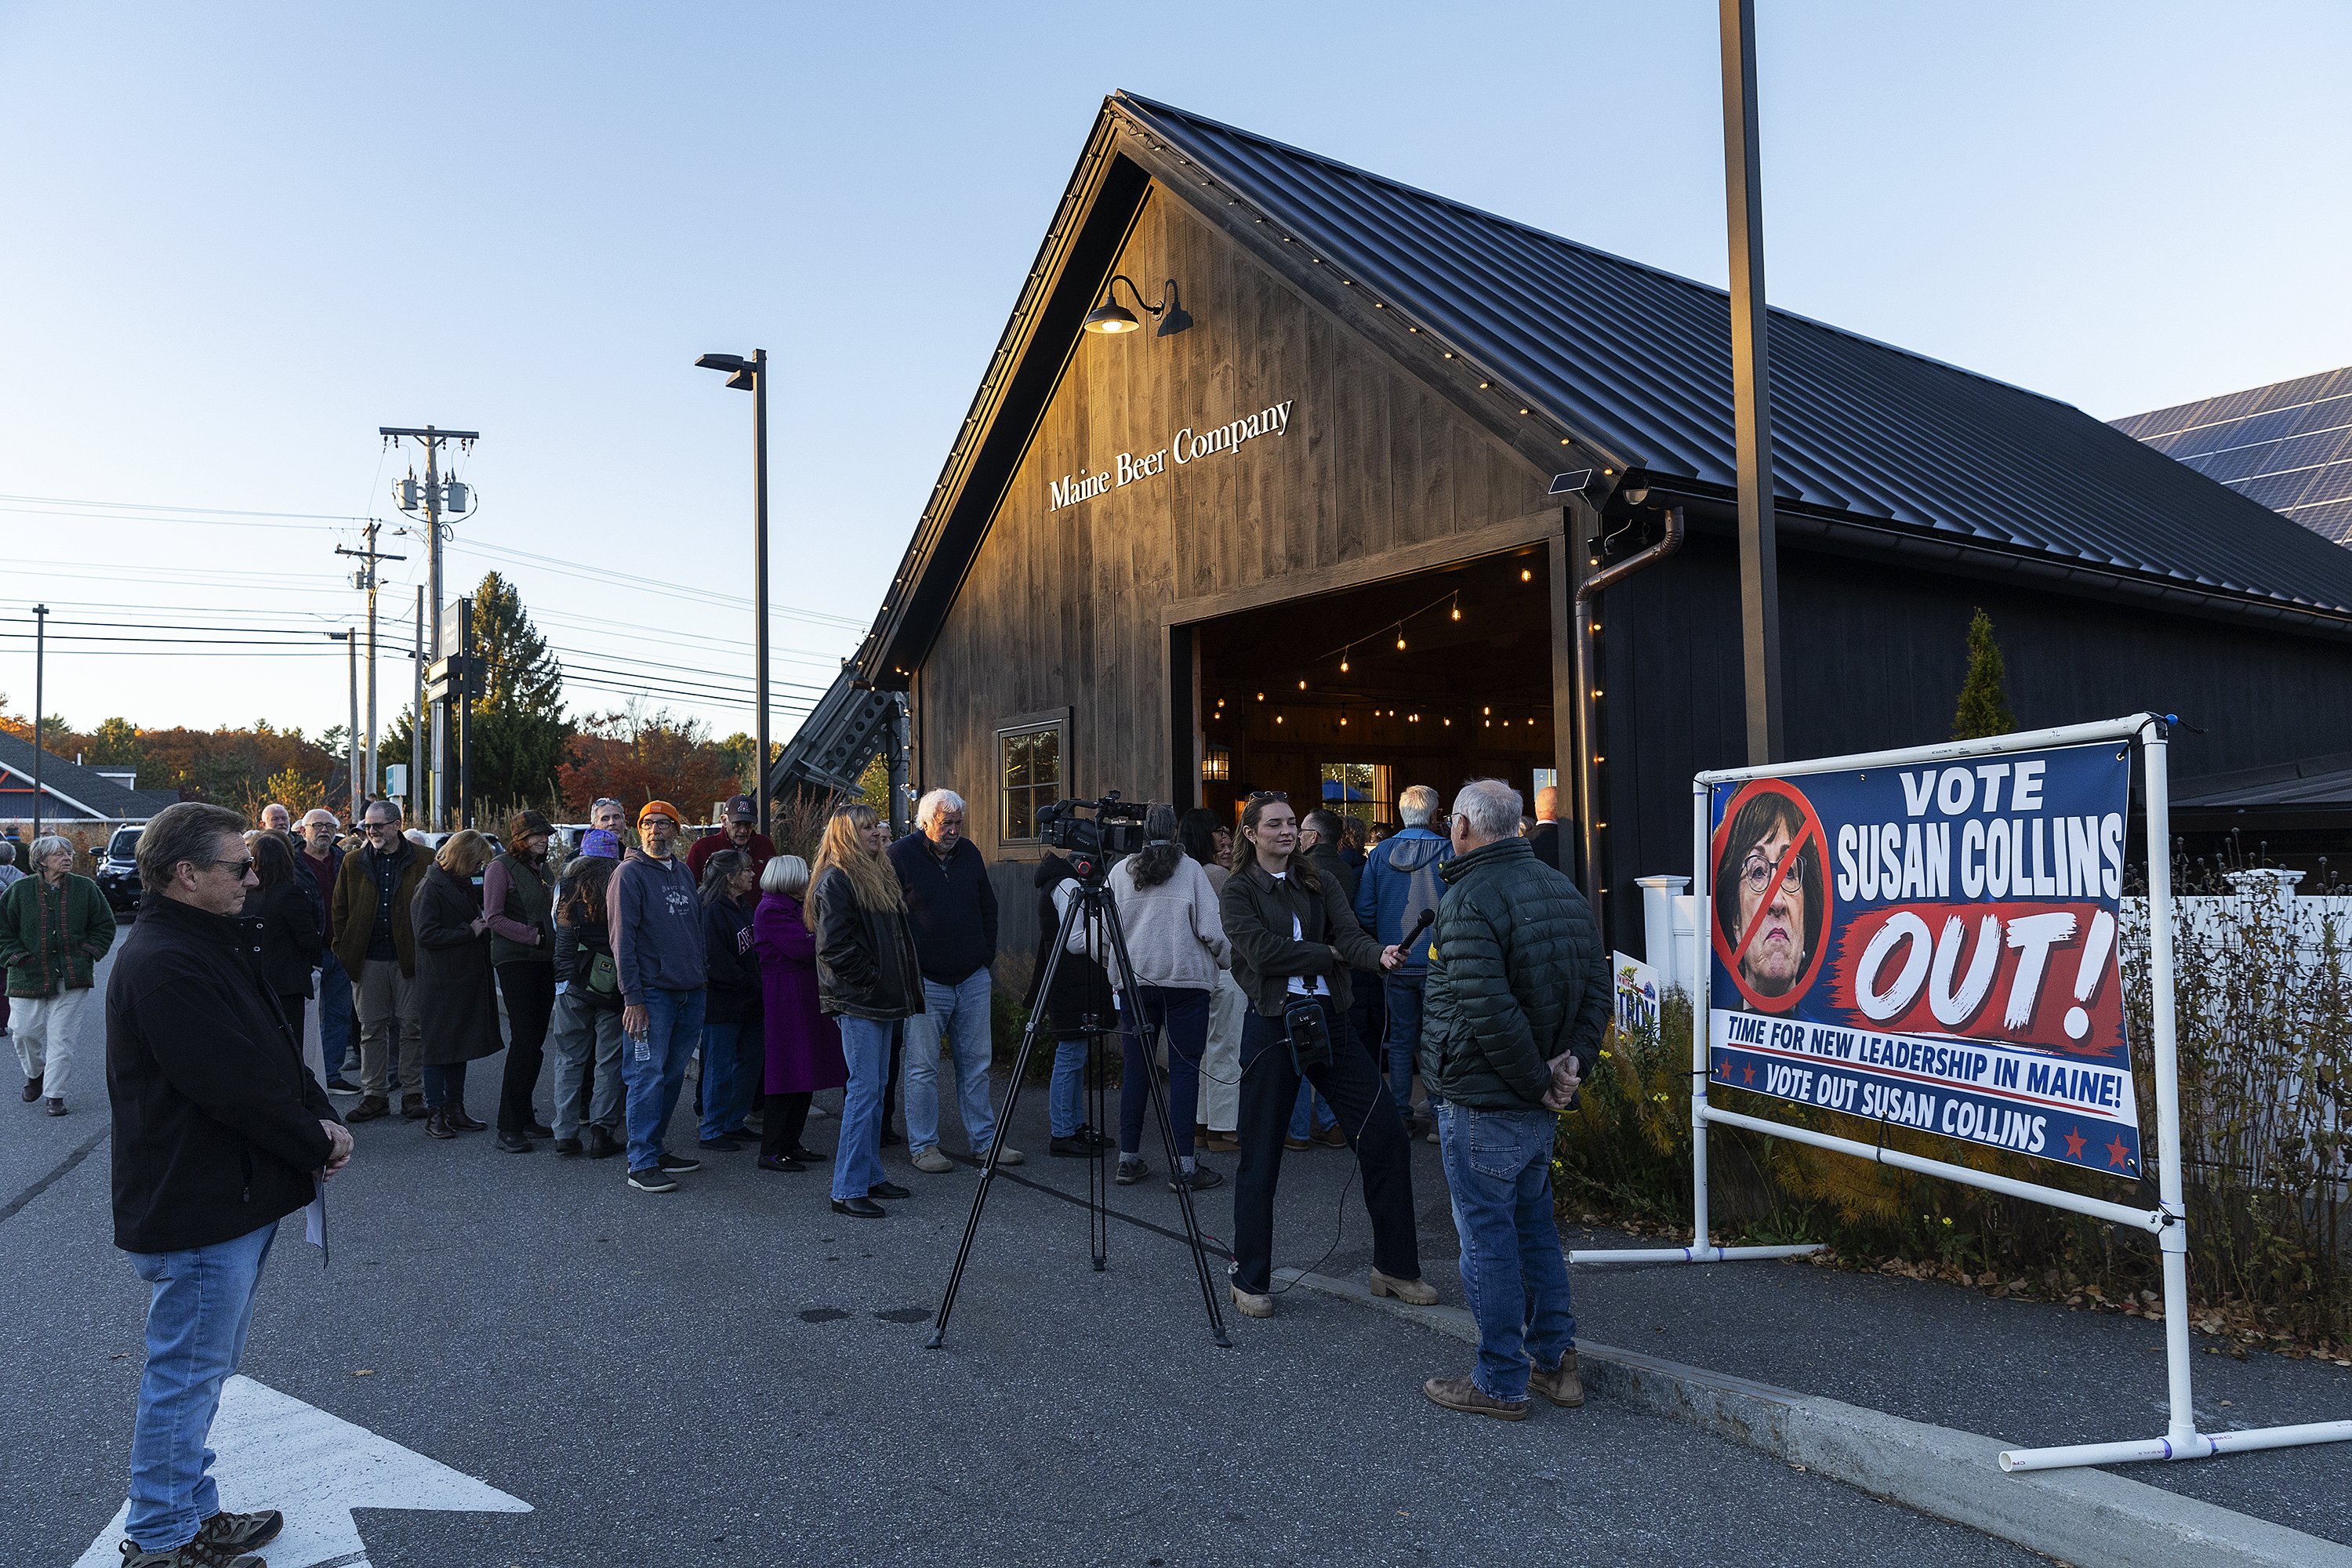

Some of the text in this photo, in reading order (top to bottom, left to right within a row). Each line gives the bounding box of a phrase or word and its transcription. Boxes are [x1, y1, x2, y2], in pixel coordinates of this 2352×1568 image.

[1049, 400, 1293, 512] Maine Beer Company
[1899, 760, 2045, 816] VOTE
[1076, 837, 1091, 846] SONY
[1837, 813, 2122, 902] SUSAN COLLINS
[1855, 909, 2114, 1039] OUT!
[1728, 1015, 2122, 1109] TIME FOR NEW LEADERSHIP IN MAINE!
[1766, 1063, 2047, 1152] VOTE OUT SUSAN COLLINS
